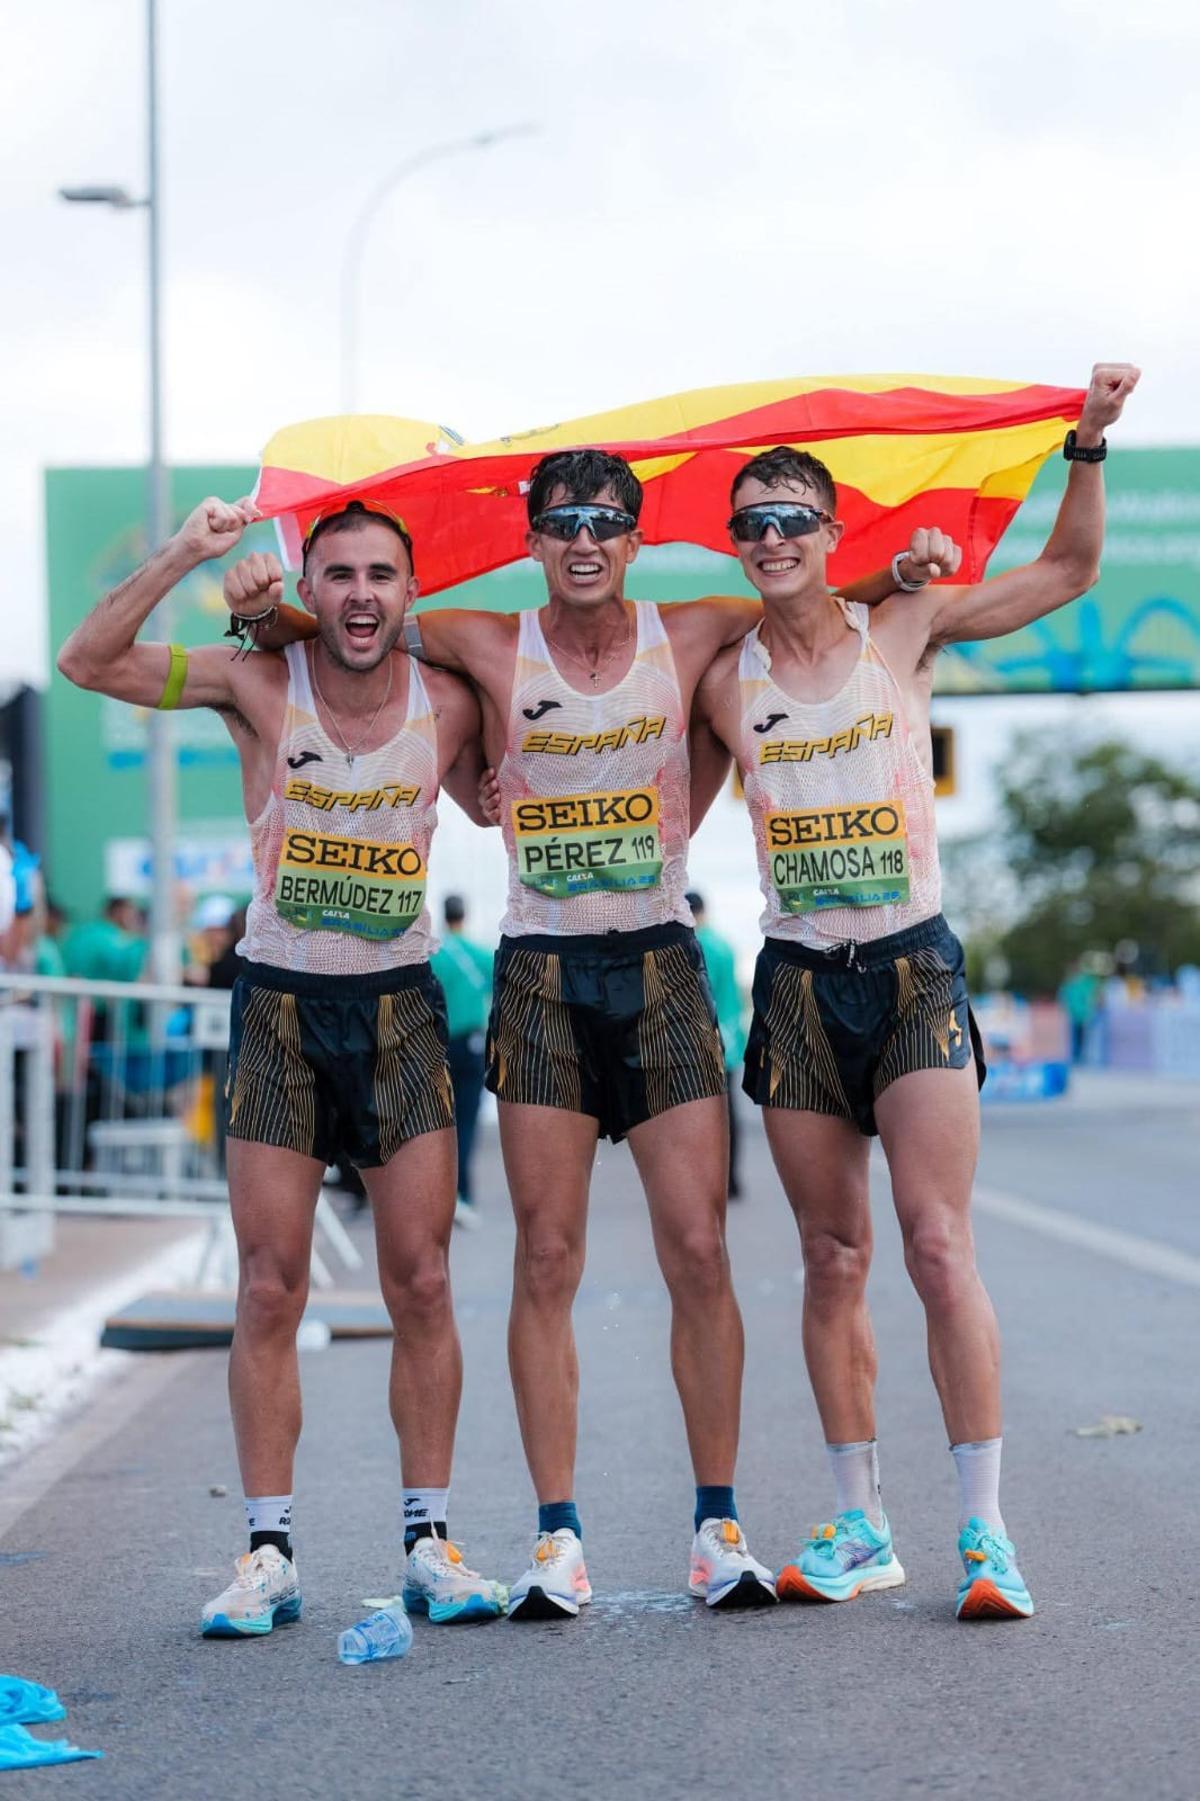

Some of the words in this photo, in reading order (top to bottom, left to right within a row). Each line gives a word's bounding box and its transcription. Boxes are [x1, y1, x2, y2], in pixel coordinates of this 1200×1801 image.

[517, 793, 652, 831] SEIKO
[770, 807, 899, 845] SEIKO
[286, 834, 421, 876] SEIKO
[524, 837, 626, 872] PÉREZ
[631, 835, 654, 859] 119
[774, 847, 875, 885] CHAMOSA
[881, 850, 903, 875] 118
[280, 875, 393, 914] BERMÚDEZ
[398, 890, 422, 913] 117
